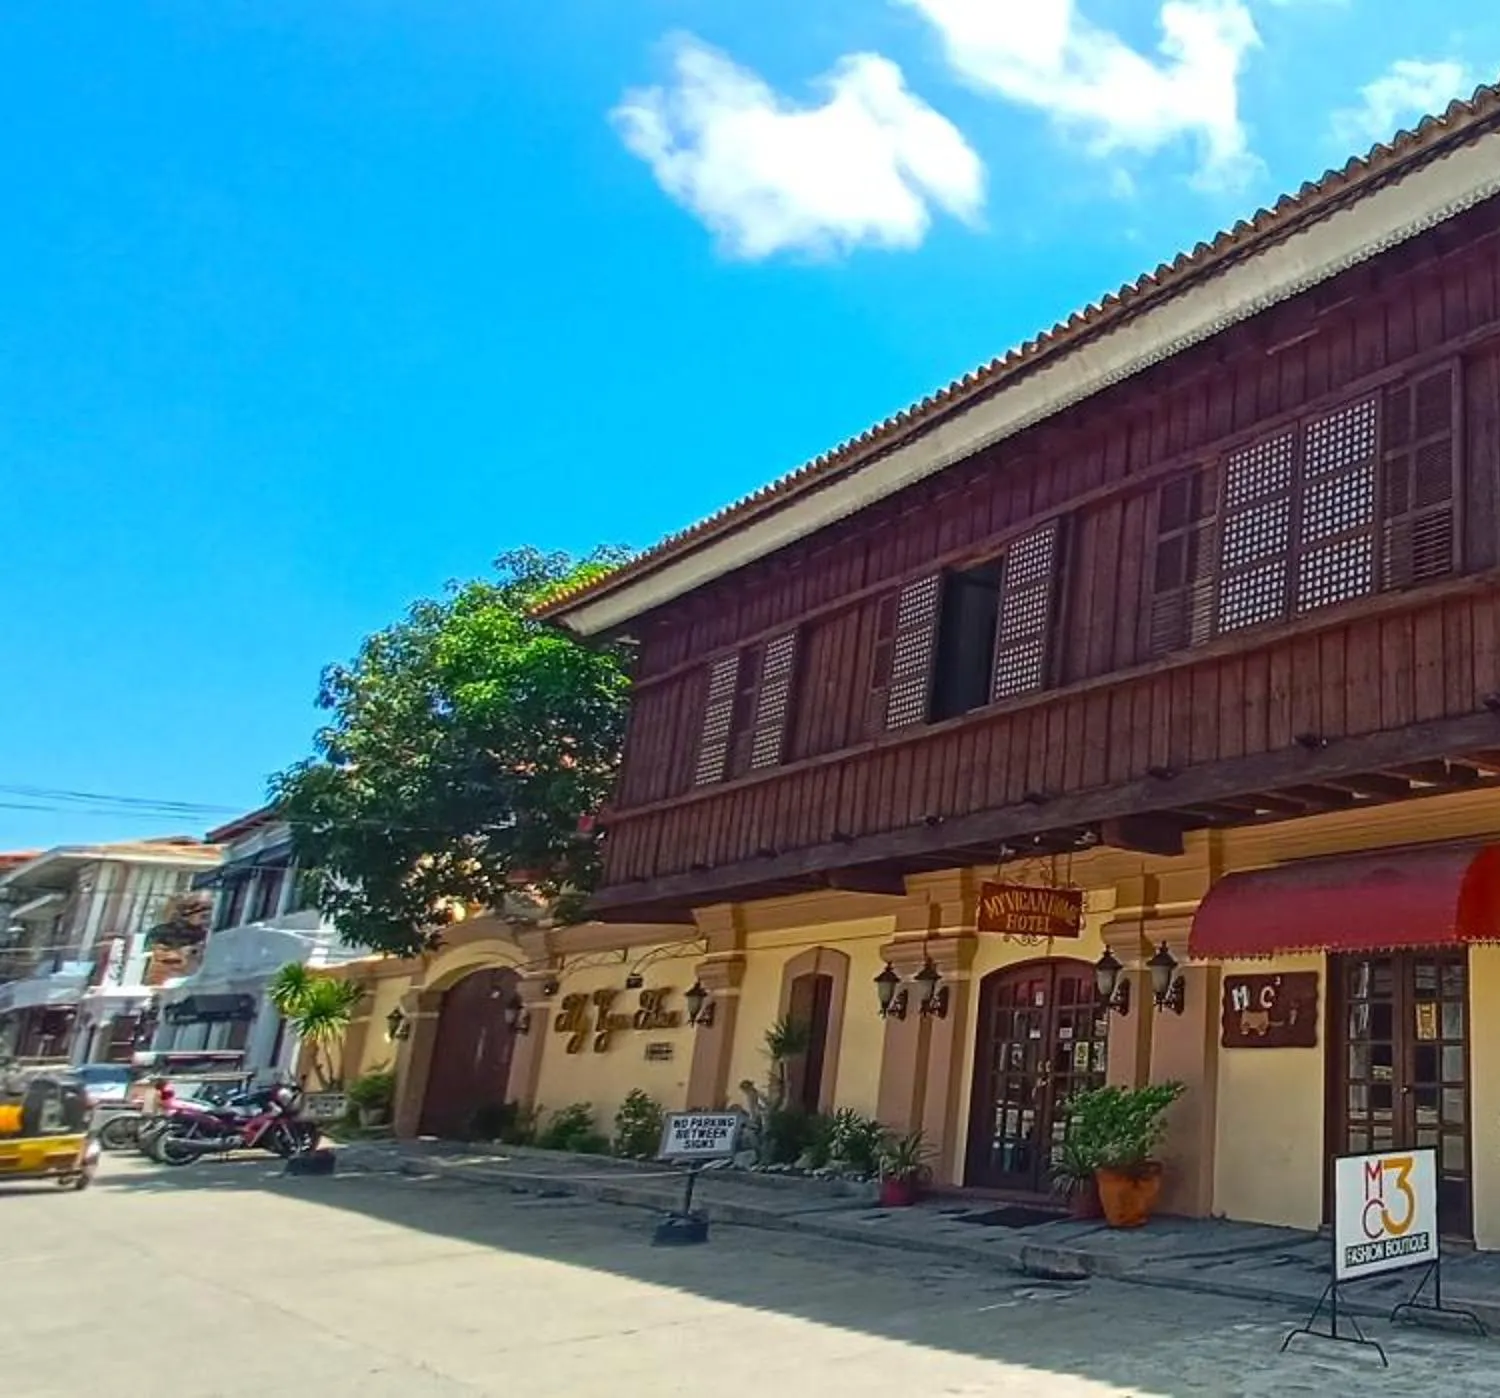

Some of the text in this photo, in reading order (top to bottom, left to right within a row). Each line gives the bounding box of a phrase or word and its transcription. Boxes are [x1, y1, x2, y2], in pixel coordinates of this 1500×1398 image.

[1006, 913, 1050, 932] HOTEL
[674, 1118, 735, 1129] NO PARKING
[675, 1128, 727, 1140] BETWEEN
[683, 1139, 715, 1149] SIGNS
[1346, 1233, 1428, 1266] FASHION BOUTIQUE
